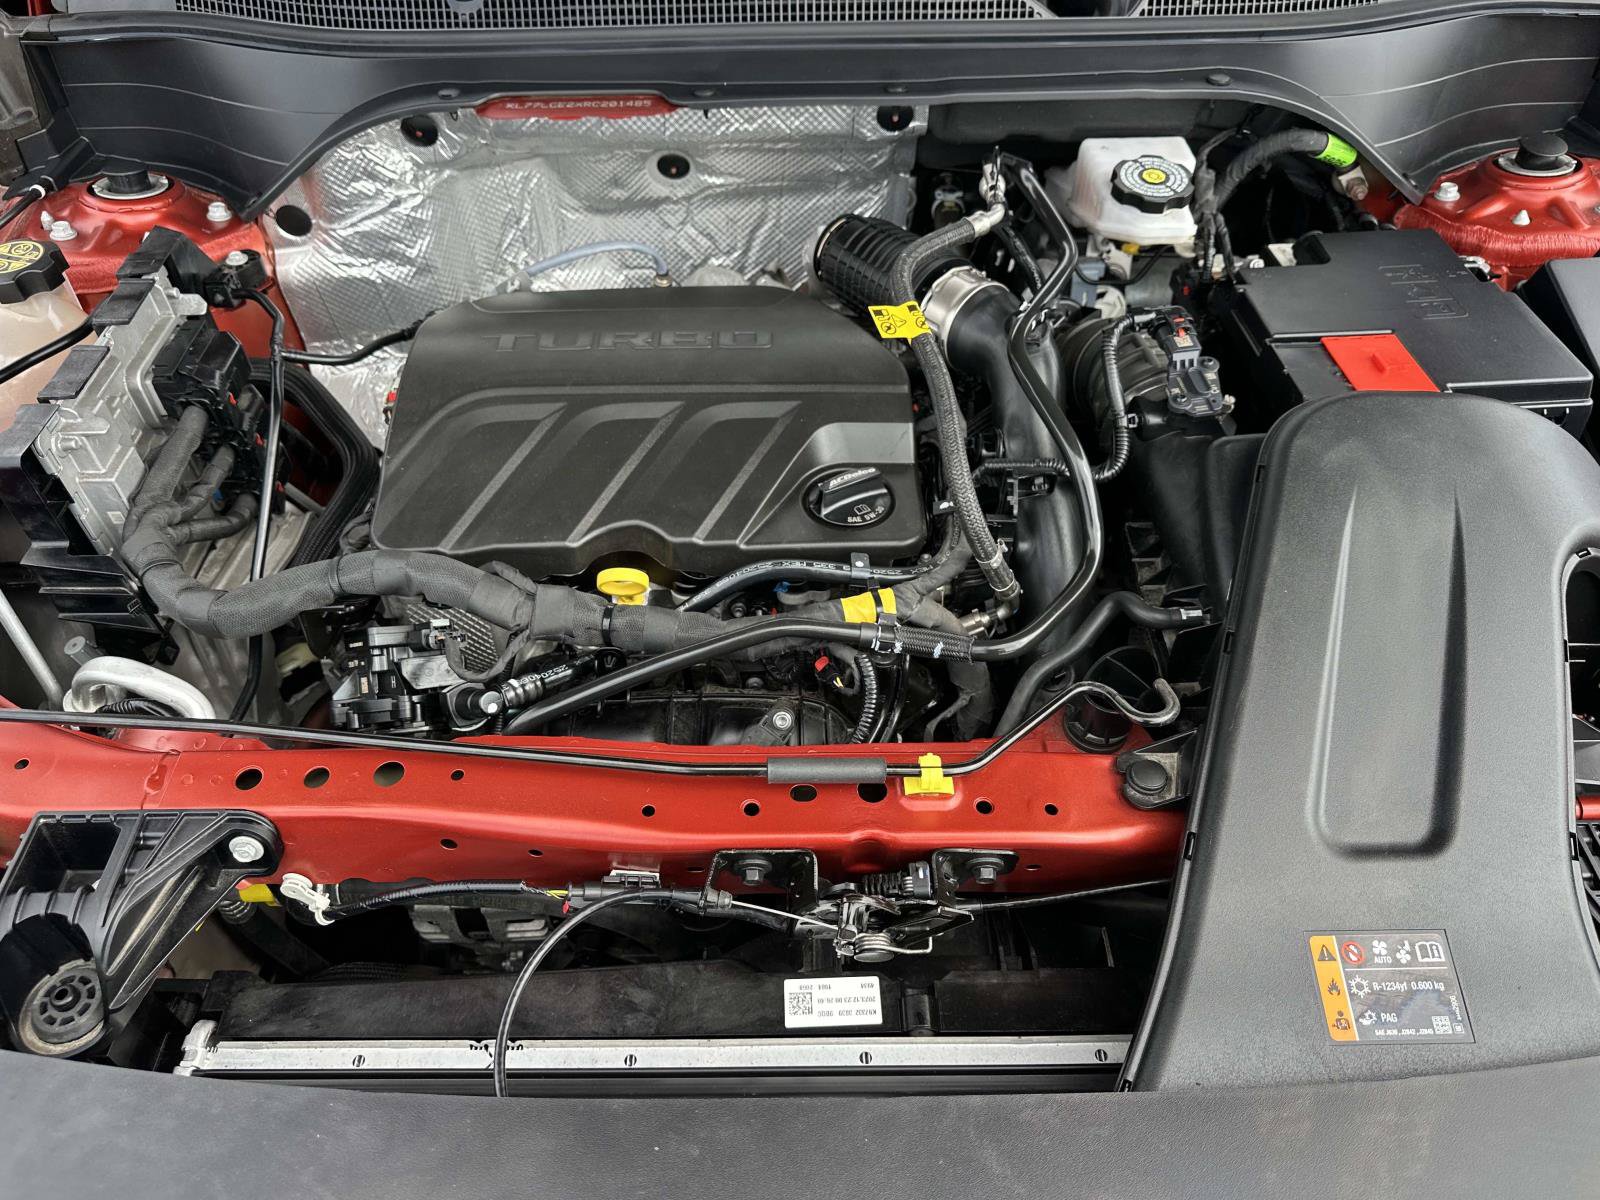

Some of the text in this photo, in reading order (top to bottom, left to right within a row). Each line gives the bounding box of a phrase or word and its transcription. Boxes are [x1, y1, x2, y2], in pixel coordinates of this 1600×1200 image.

[480, 331, 773, 352] TURBO
[1374, 955, 1393, 964] AUTO
[1410, 980, 1433, 991] 0.600
[1434, 980, 1446, 992] kg
[1380, 1012, 1399, 1023] PAG
